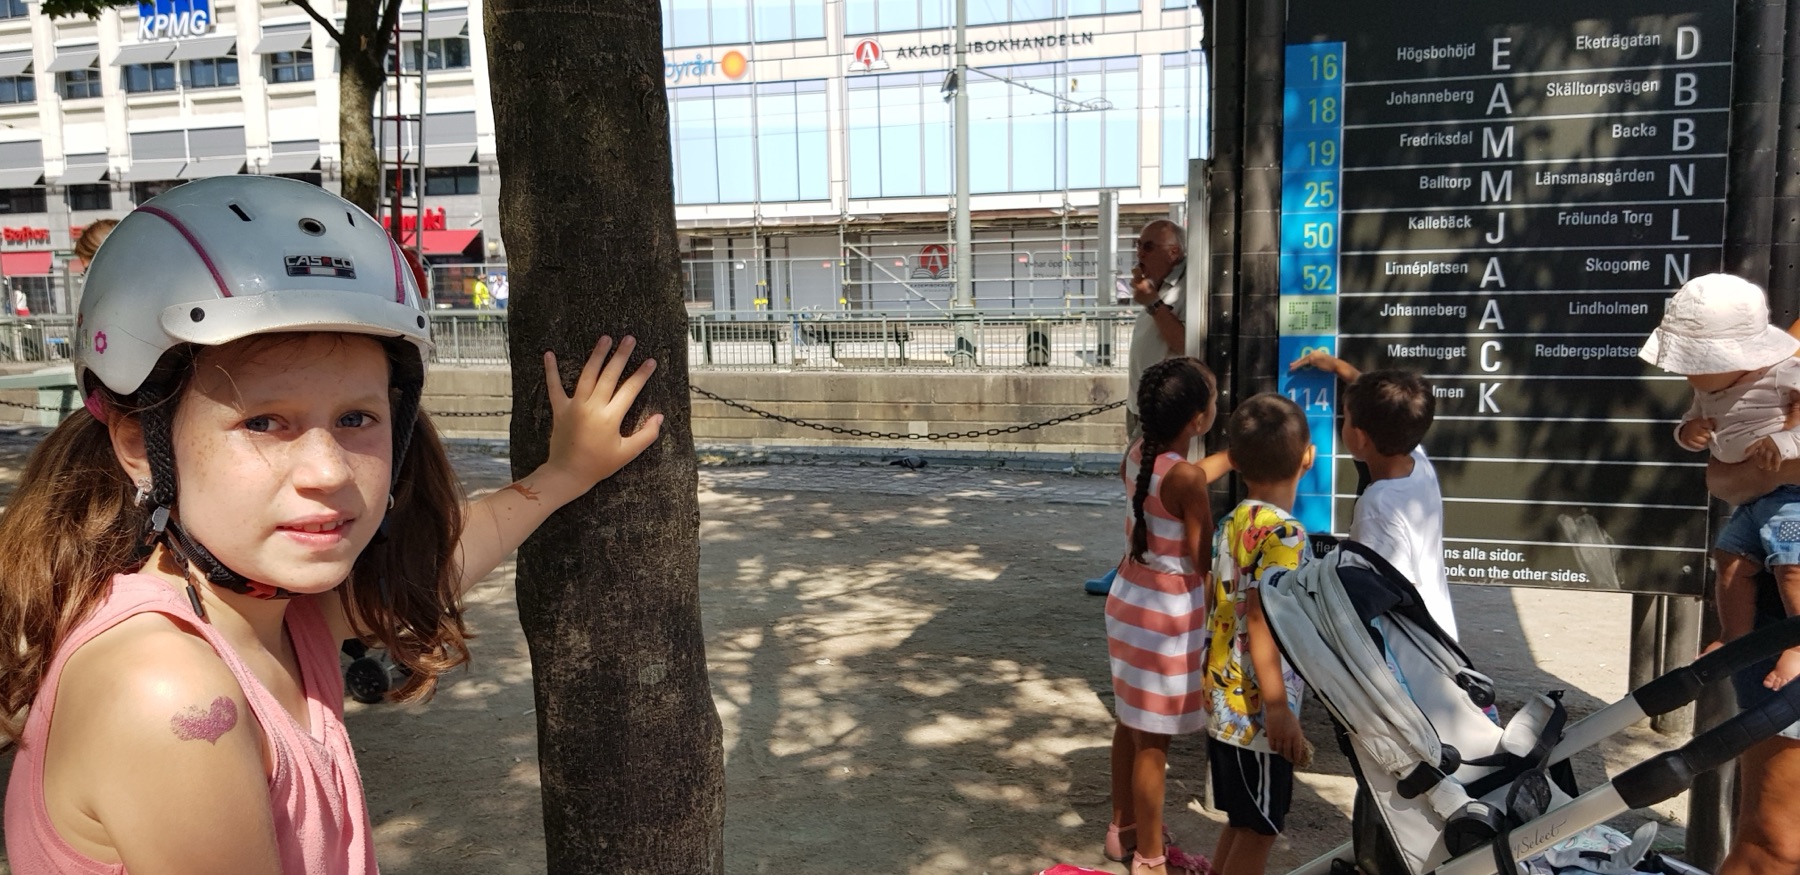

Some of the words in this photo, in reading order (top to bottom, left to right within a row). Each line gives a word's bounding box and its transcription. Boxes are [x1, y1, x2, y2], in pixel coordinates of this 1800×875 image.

[139, 9, 207, 39] KPMG
[896, 32, 1093, 59] AKADEIBOKHANDELN
[1309, 54, 1337, 80] 16
[1396, 43, 1476, 62] Högsbohöjd
[1492, 37, 1511, 71] E
[1575, 34, 1661, 52] Eketrägatan
[1676, 26, 1700, 61] D
[1308, 97, 1336, 124] 18
[1386, 88, 1474, 106] Johanneberg
[1486, 83, 1512, 115] A
[1546, 79, 1659, 99] Skälltorpsvägen
[1674, 73, 1698, 107] B
[1307, 140, 1336, 166] 19
[1400, 131, 1473, 148] Fredriksdal
[1482, 126, 1514, 159] M
[1612, 123, 1657, 139] Backa
[1672, 118, 1696, 152] B
[1304, 181, 1334, 208] 25
[1419, 174, 1472, 191] Balltorp
[1480, 170, 1513, 203] M
[1535, 168, 1655, 187] Länsmansgården
[1668, 163, 1695, 197] N
[1303, 222, 1333, 249] 50
[1408, 213, 1472, 230] Kallebäck
[1485, 212, 1505, 245] J
[1558, 211, 1618, 227] Frölunda
[1622, 210, 1653, 228] Torg
[1671, 209, 1690, 241] L
[285, 255, 354, 270] CASCO
[1303, 265, 1332, 291] 52
[1385, 260, 1468, 277] Linnéplatsen
[1480, 257, 1506, 289] A
[1585, 257, 1651, 275] Skogome
[1664, 253, 1690, 286] N
[1288, 301, 1332, 330] 55
[1380, 303, 1467, 318] Johanneberg
[1478, 299, 1505, 330] A
[1569, 301, 1649, 316] Lindholmen
[1387, 344, 1467, 360] Masthugget
[1480, 341, 1502, 372] C
[1535, 344, 1641, 360] Redbergsplatse
[1288, 387, 1330, 412] 114
[1478, 383, 1502, 413] K
[1462, 547, 1486, 560] alla
[1489, 549, 1525, 562] sidor.
[1443, 564, 1466, 577] ook
[1468, 568, 1485, 578] on
[1487, 566, 1509, 579] the
[1512, 567, 1548, 581] other
[1550, 569, 1590, 583] sides.
